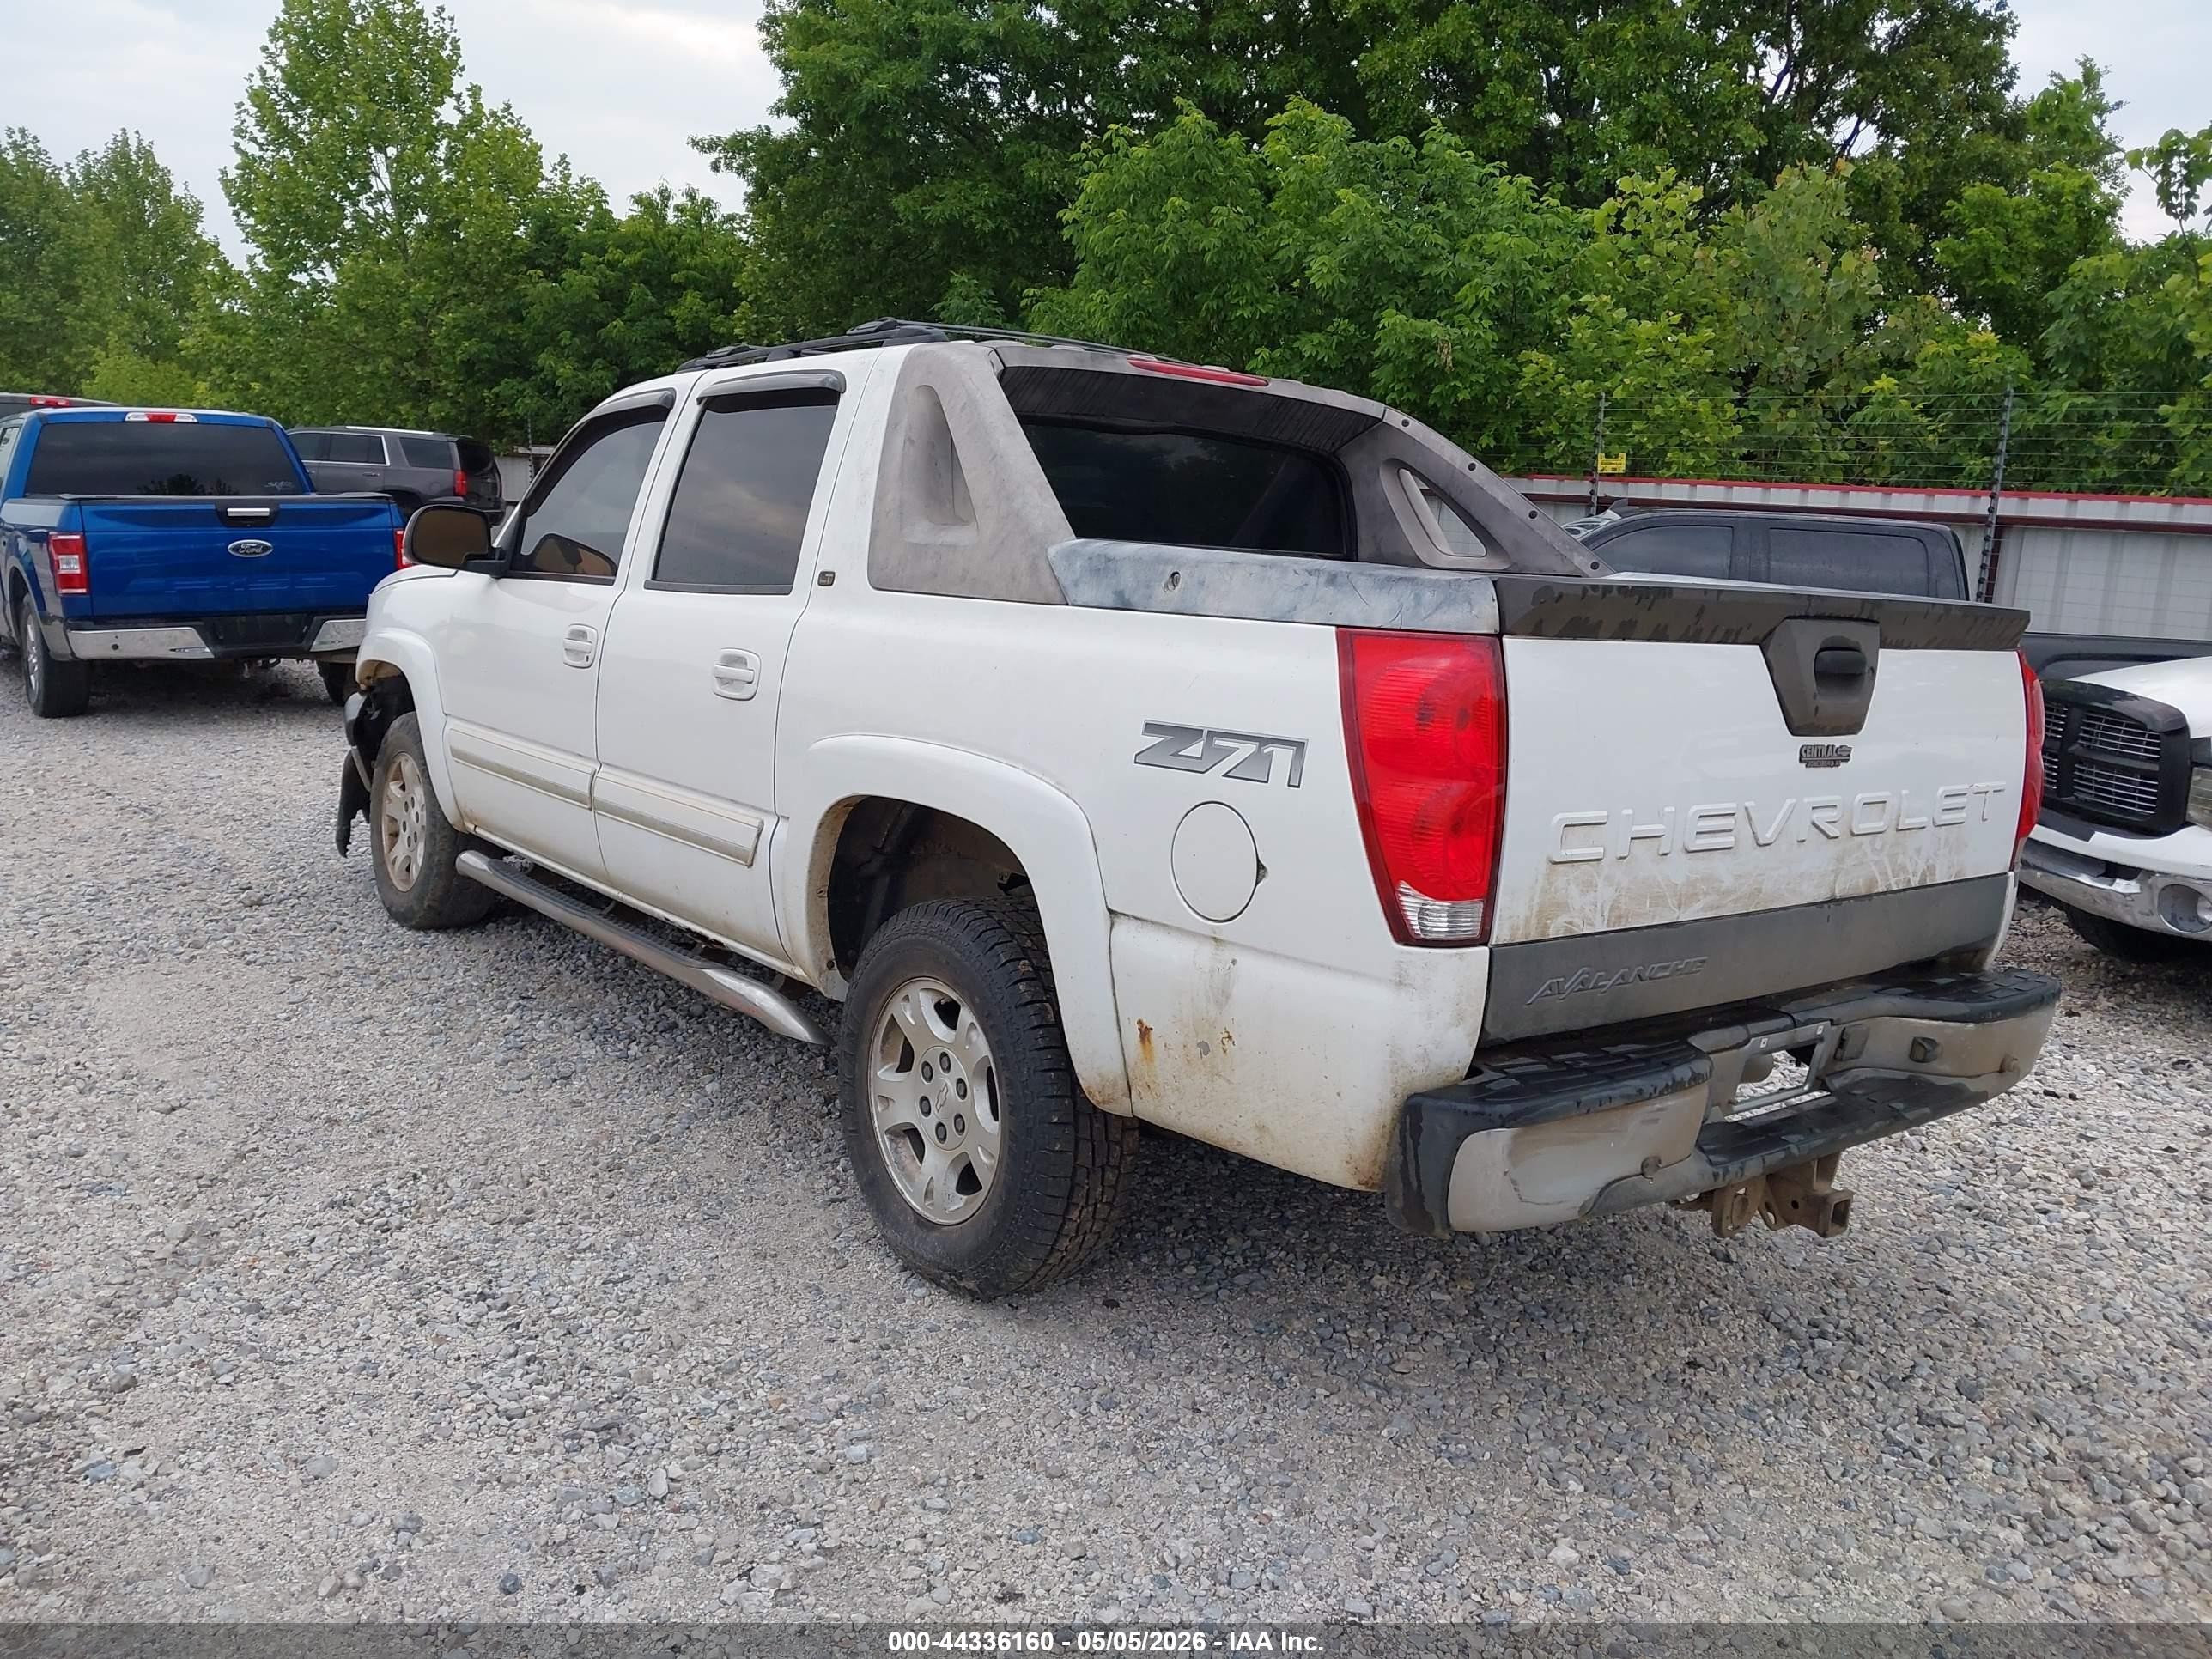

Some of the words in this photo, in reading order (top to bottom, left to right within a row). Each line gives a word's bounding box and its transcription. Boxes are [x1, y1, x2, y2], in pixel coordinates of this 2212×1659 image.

[239, 543, 263, 554] Ford
[1133, 720, 1310, 789] Z71
[1801, 745, 1836, 757] CENTRAL
[1548, 781, 2007, 864] CHEVROLET
[1526, 957, 1709, 1005] AVALANCHE
